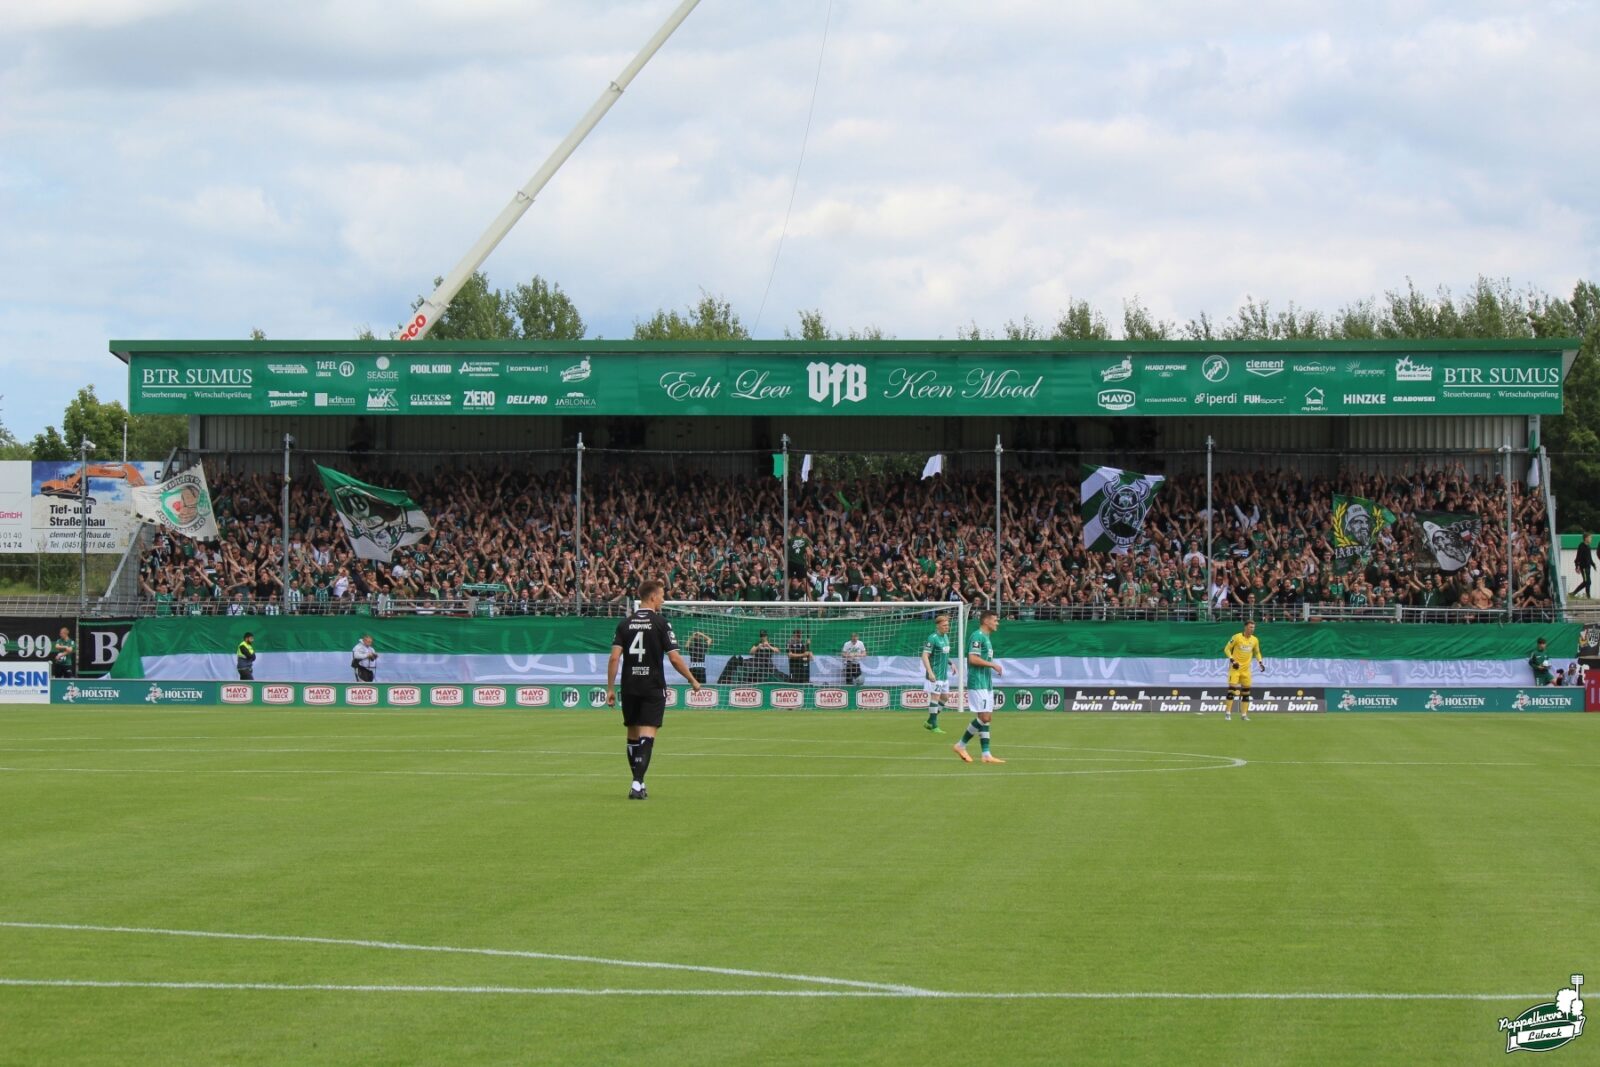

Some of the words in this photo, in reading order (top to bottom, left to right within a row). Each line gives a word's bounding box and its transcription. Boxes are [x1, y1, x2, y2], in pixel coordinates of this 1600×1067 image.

[316, 361, 337, 370] TAFEL
[410, 364, 431, 374] POOL
[459, 362, 492, 374] Abraham
[142, 368, 180, 384] BTR
[186, 368, 252, 384] SUMUS
[1444, 368, 1482, 384] BTR
[1489, 368, 1559, 384] SUMUS
[659, 372, 720, 400] Echt
[806, 361, 867, 407] VfB
[883, 368, 955, 399] Keen
[961, 369, 1043, 399] Mood
[506, 395, 548, 404] DELLPRO
[1101, 394, 1132, 402] MAYO
[1206, 393, 1237, 406] iperdi
[1344, 394, 1386, 404] HINZKE
[1443, 390, 1490, 398] Steuerberatung
[1498, 390, 1558, 399] Wirtschaftsprüfung
[328, 396, 356, 404] aditum
[50, 505, 72, 514] Tief-
[50, 516, 106, 527] Straßebau
[18, 634, 52, 658] 99
[629, 632, 646, 662] 4
[1072, 701, 1102, 710] bwin
[1112, 701, 1142, 710] bwin
[1160, 702, 1190, 711] bwin
[1248, 702, 1278, 711] bwin
[1288, 702, 1318, 711] bwin
